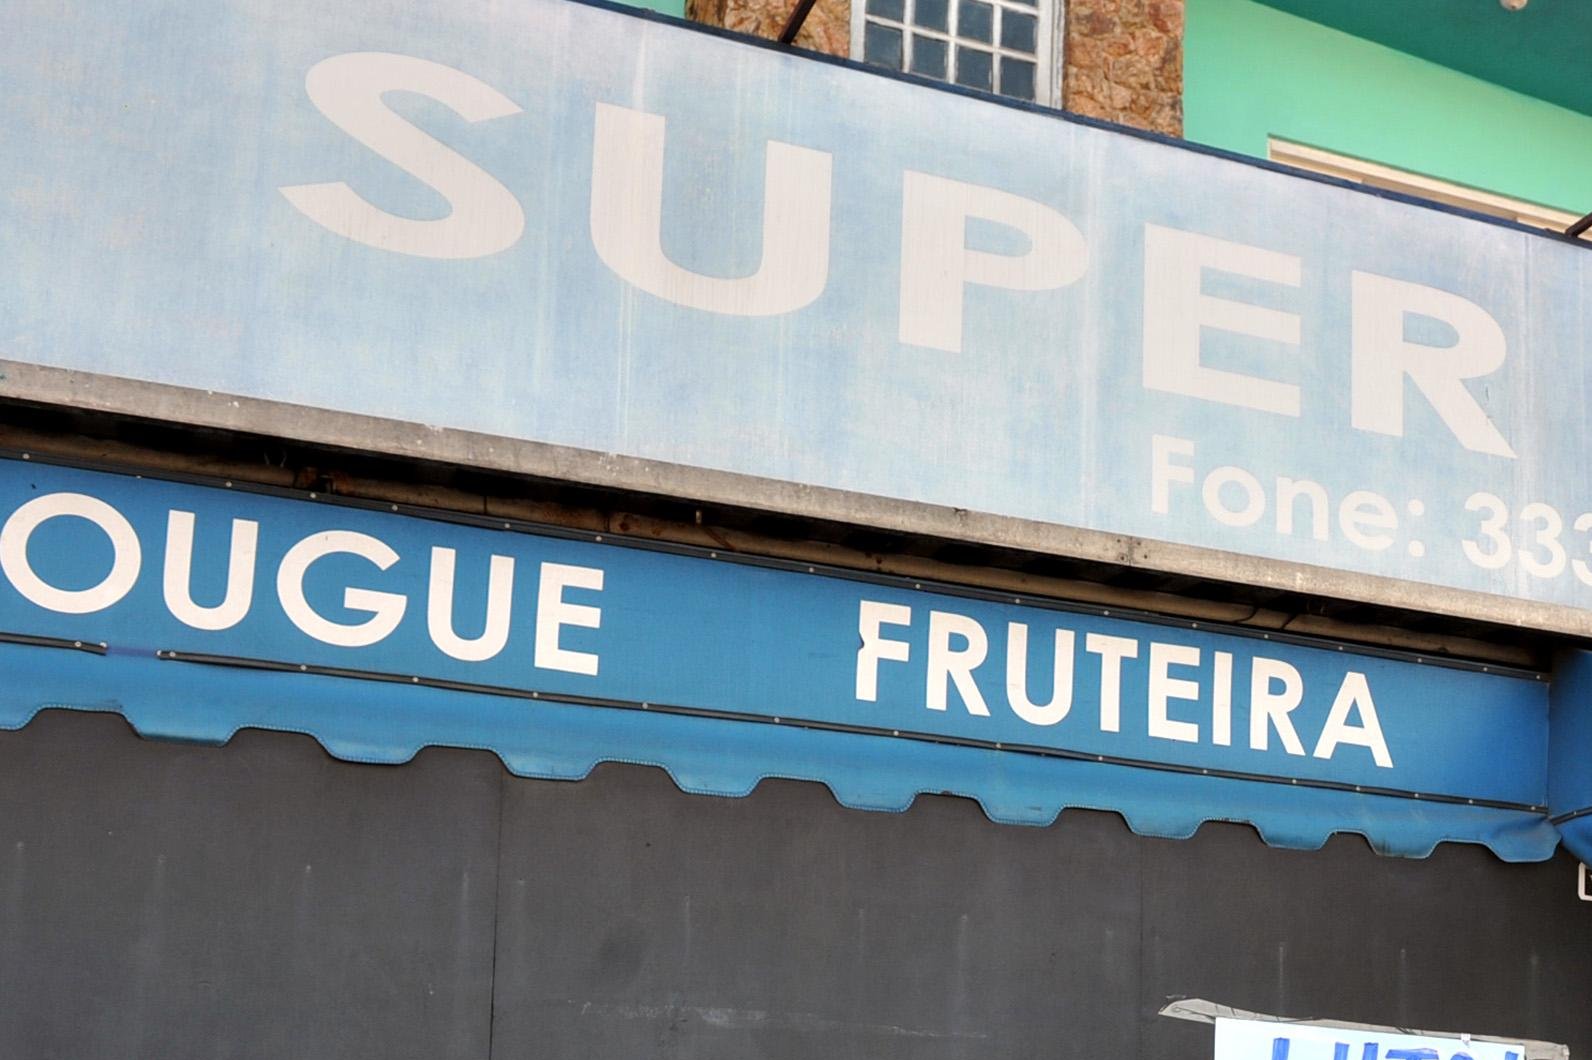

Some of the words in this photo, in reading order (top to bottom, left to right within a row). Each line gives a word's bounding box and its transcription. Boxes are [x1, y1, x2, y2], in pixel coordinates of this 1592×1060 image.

[278, 50, 1517, 460] SUPER
[0, 491, 606, 678] OUGUE
[1149, 434, 1425, 558] Fone:
[854, 599, 1395, 769] FRUTEIRA
